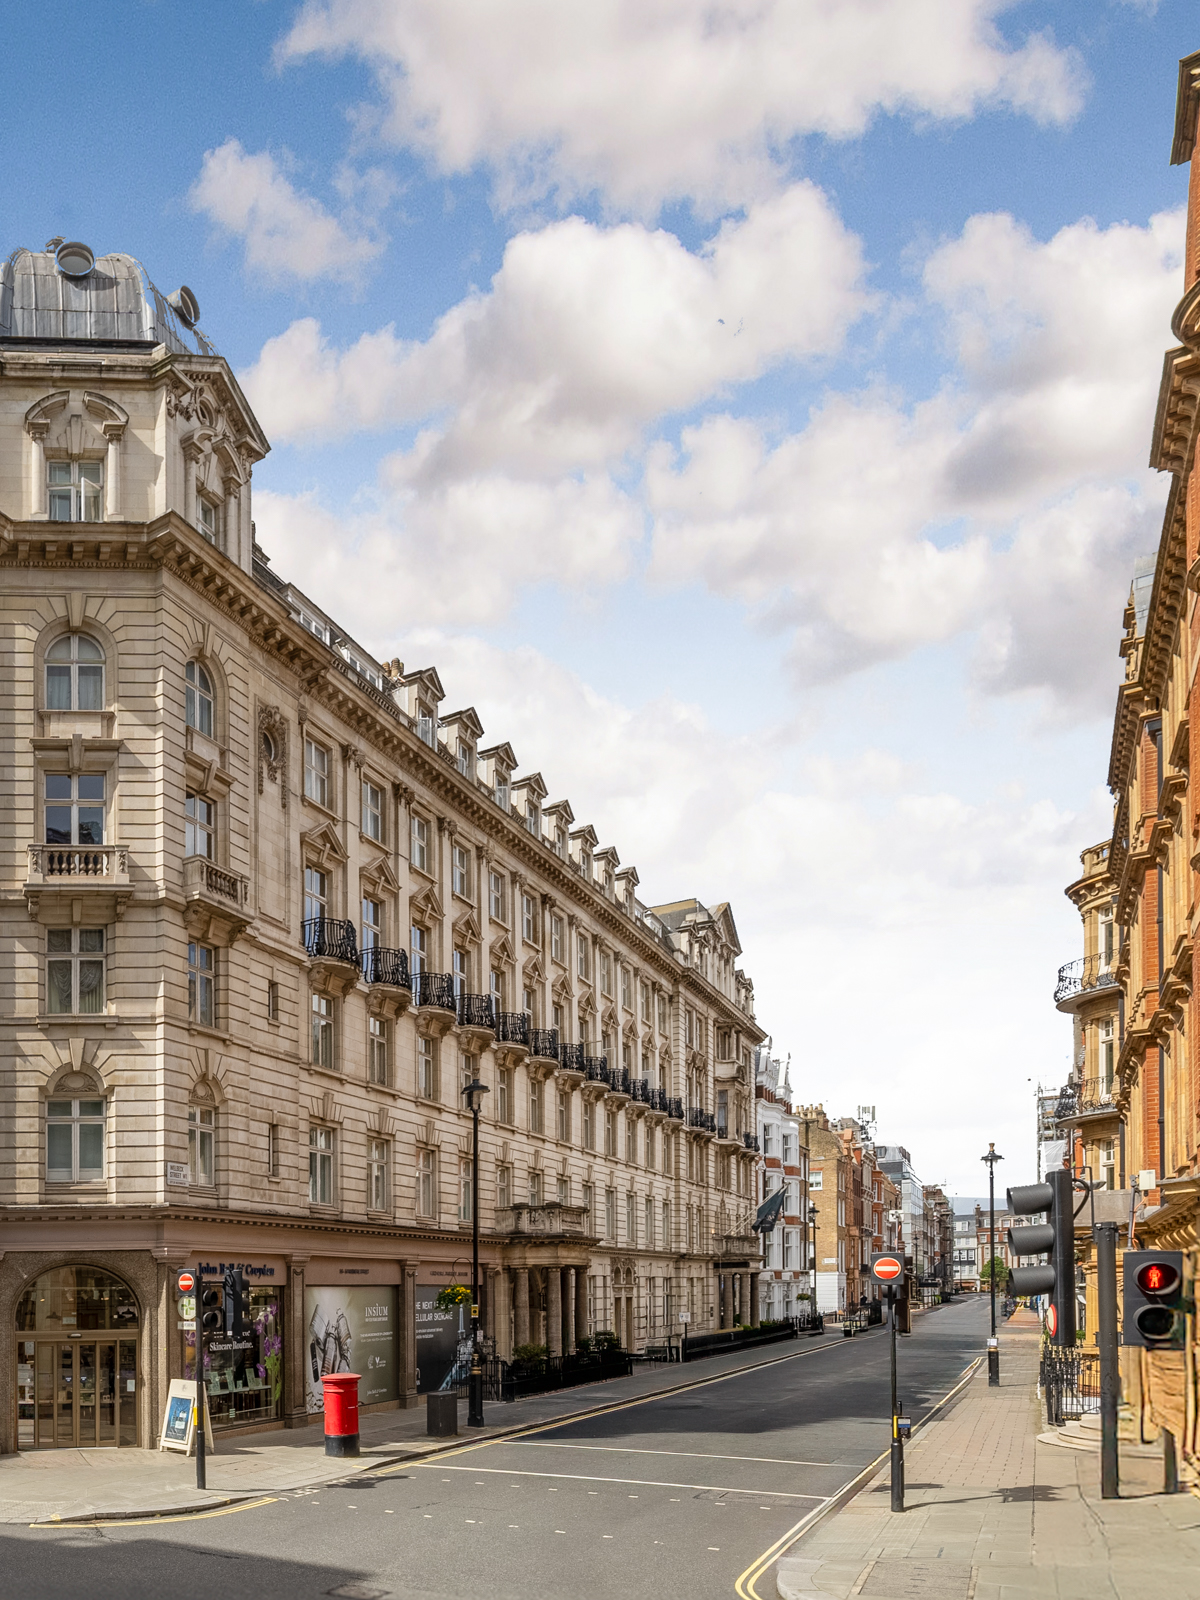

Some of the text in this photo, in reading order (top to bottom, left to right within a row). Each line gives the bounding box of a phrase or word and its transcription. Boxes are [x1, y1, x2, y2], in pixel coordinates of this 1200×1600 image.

[198, 1262, 218, 1276] John
[245, 1263, 275, 1279] Croyden
[422, 1301, 433, 1310] NEXT
[416, 1313, 433, 1322] ELLULAR
[210, 1340, 253, 1351] Skincare Routine.
